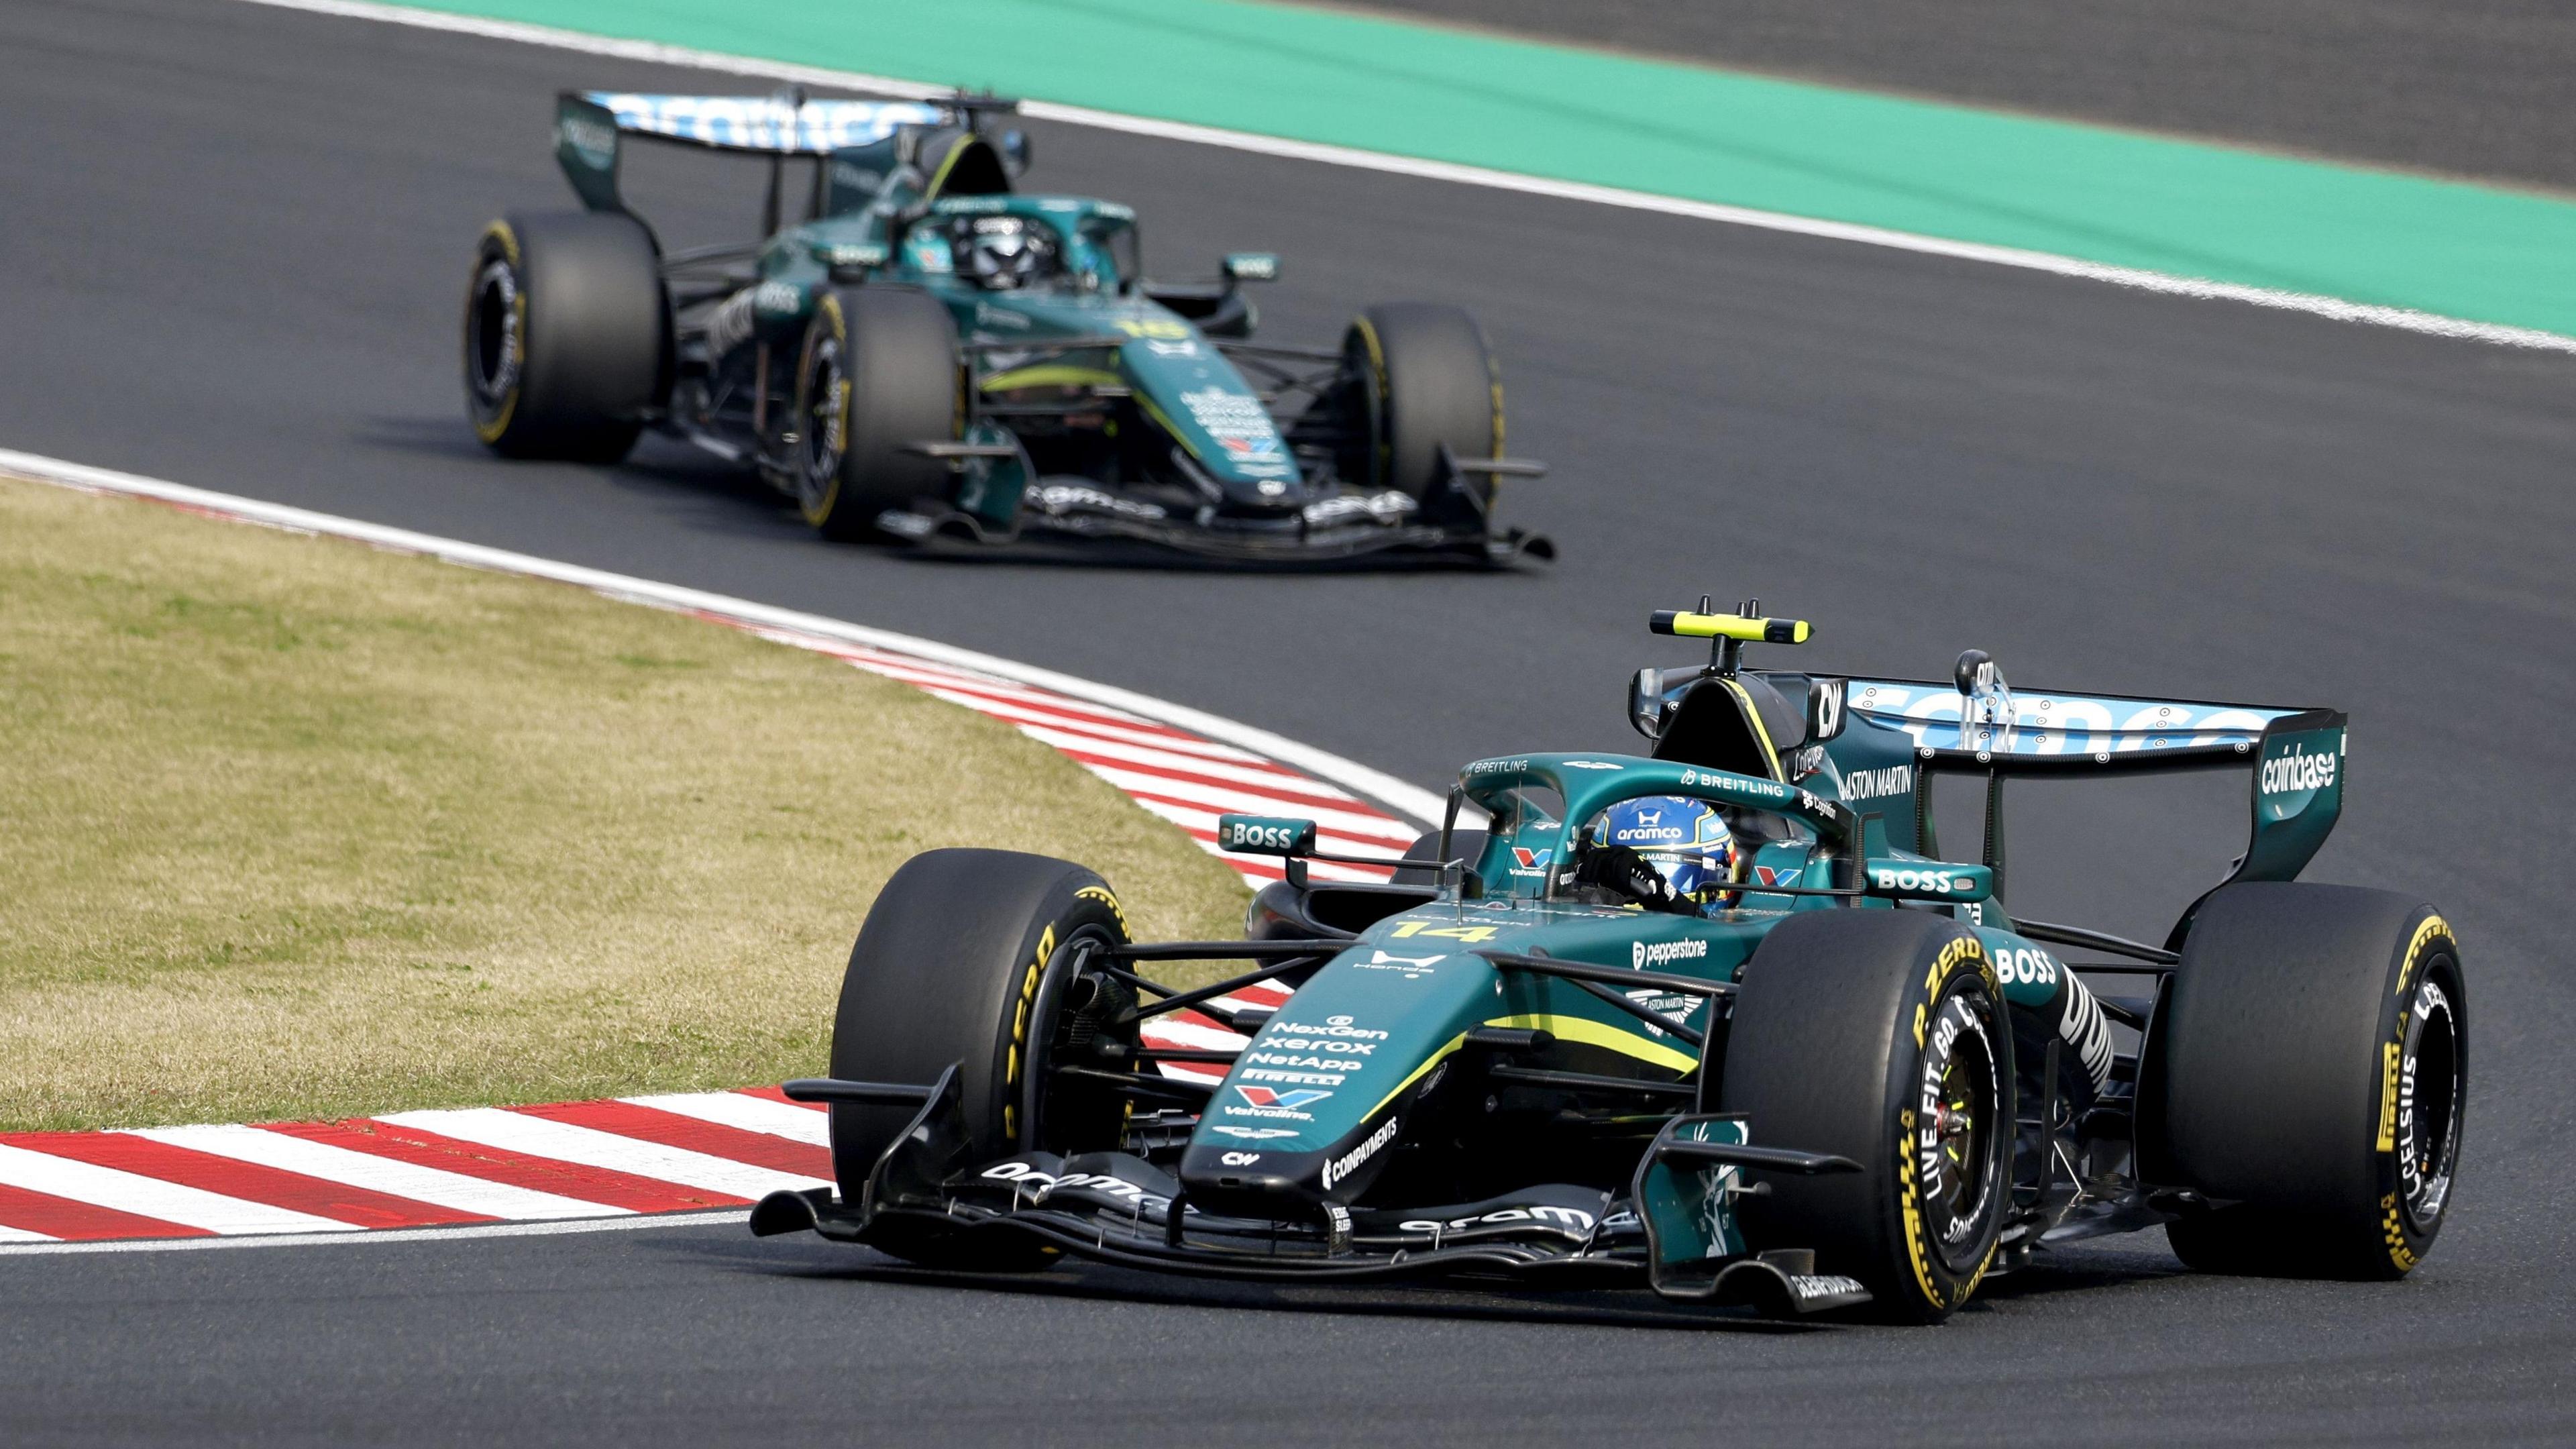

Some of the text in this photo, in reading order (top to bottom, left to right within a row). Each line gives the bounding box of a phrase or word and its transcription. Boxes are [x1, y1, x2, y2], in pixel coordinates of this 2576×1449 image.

[1474, 759, 1528, 773] BREITLING
[2262, 743, 2336, 794] coinbase
[1700, 773, 1784, 798] BREITLING
[1876, 764, 1912, 797] MARTIN
[1814, 795, 1837, 820] Cognition
[1233, 822, 1292, 849] BOSS
[1617, 826, 1682, 841] aramco
[1646, 852, 1680, 862] MARTIN
[1509, 867, 1546, 878] Valvolin
[1878, 868, 1952, 894] BOSS
[1390, 921, 1499, 943] 14
[1646, 939, 1707, 967] pepperstone
[1994, 948, 2057, 985] BOSS
[1271, 1022, 1389, 1040] NexGen
[1258, 1037, 1377, 1055] xerox
[1246, 1052, 1362, 1071] NetApp
[1240, 1068, 1346, 1087] PIRELLI
[2400, 1054, 2416, 1180] CELSIUS
[1332, 1116, 1397, 1182] COINPAYMENTS
